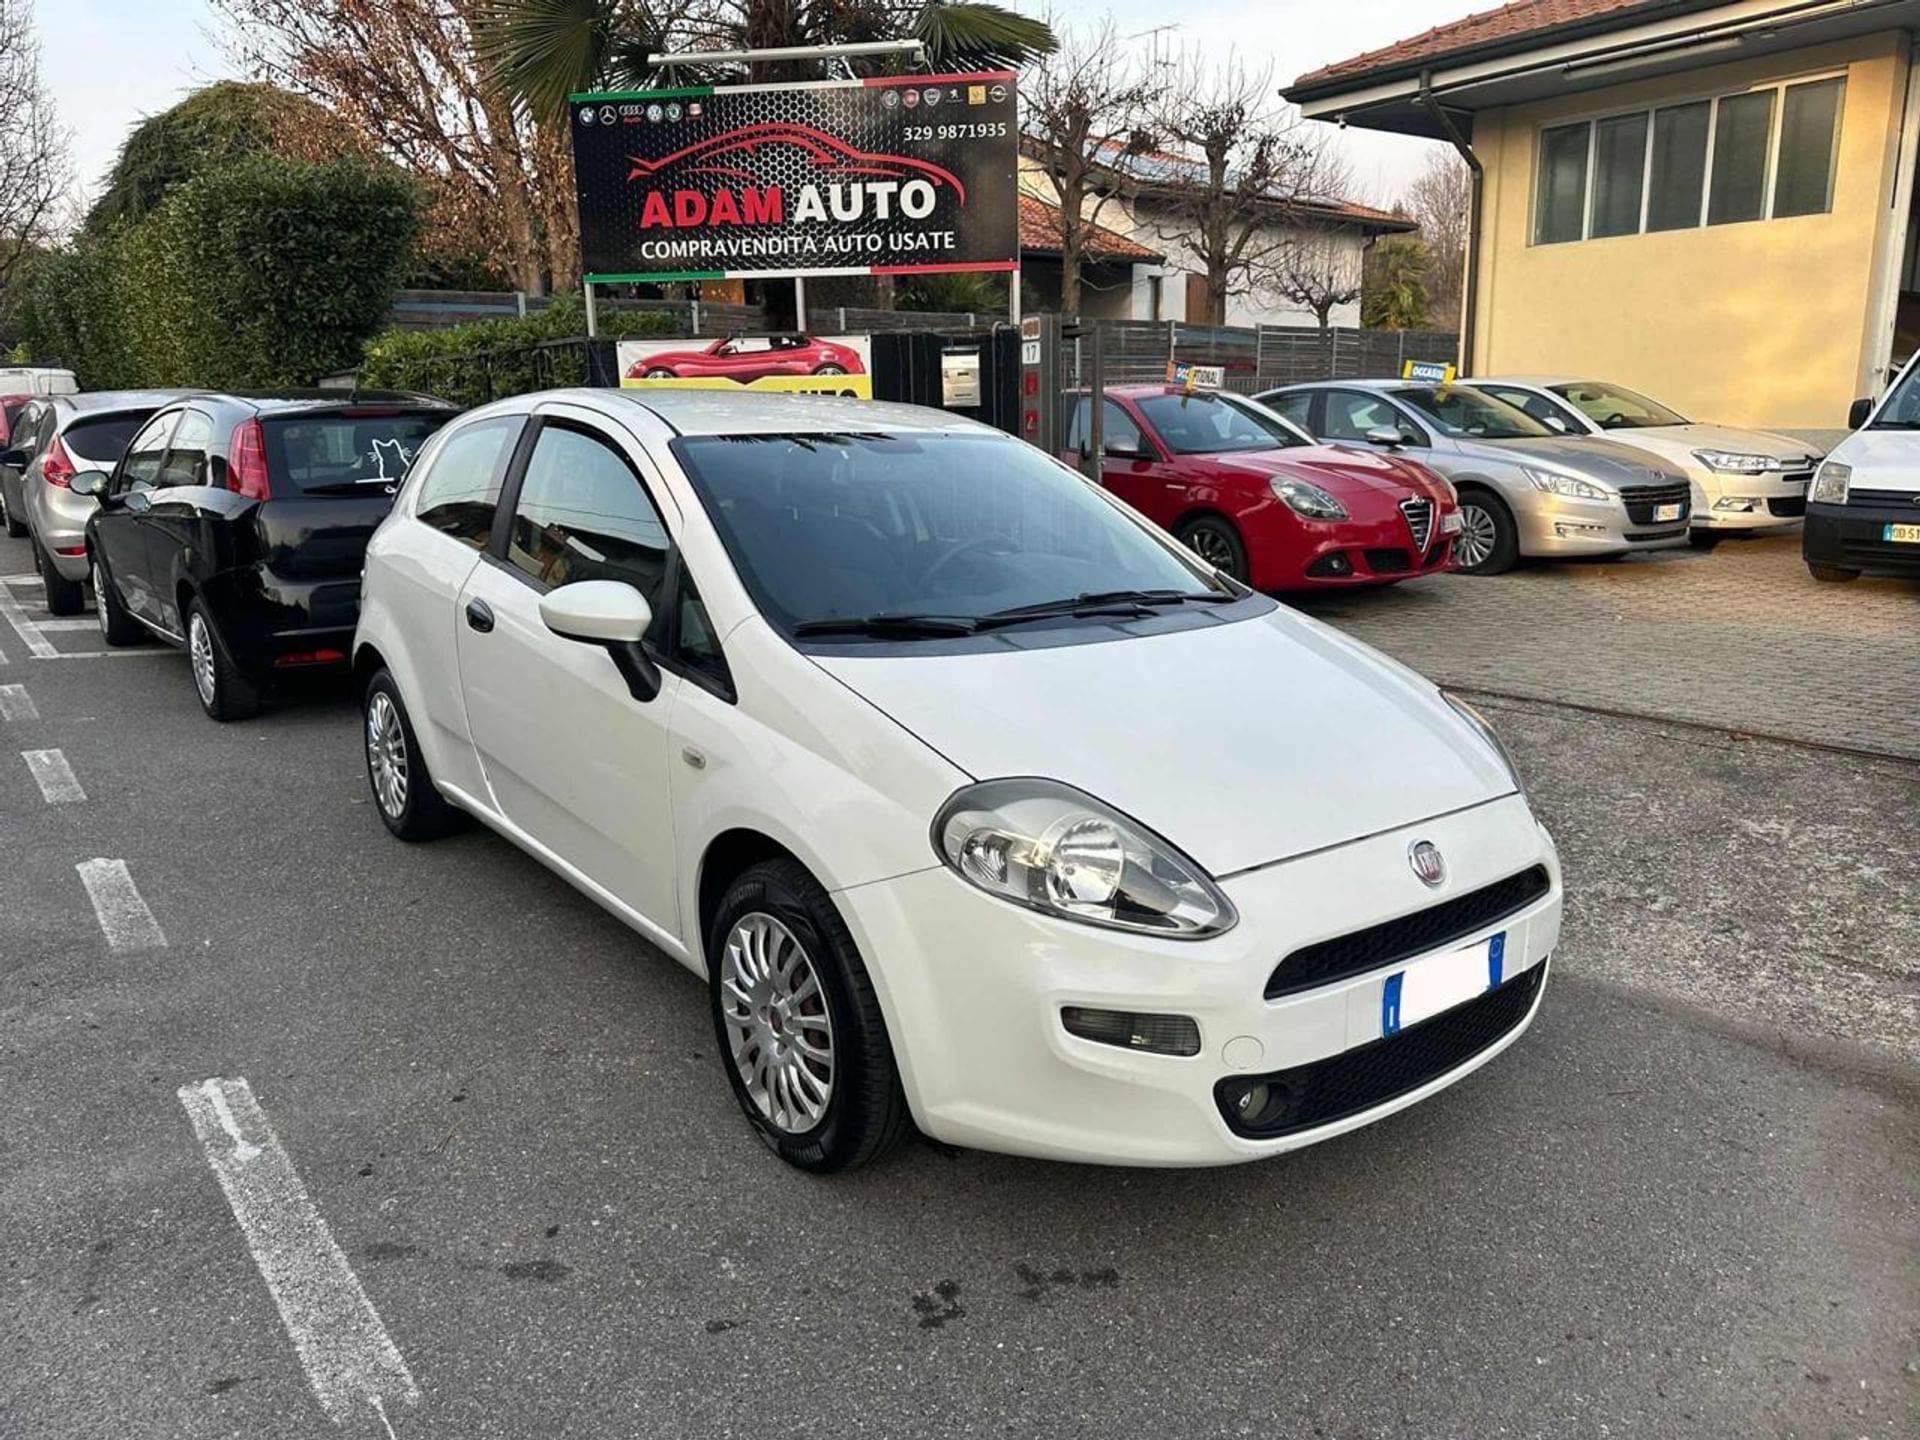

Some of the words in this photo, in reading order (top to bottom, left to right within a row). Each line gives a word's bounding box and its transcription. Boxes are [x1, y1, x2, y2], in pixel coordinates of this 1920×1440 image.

[903, 126, 933, 141] 329
[937, 122, 1007, 139] 9871935
[640, 186, 784, 229] ADAM
[794, 179, 937, 223] AUTO
[641, 235, 818, 260] COMPRAVENDITA
[823, 233, 882, 253] AUTO
[888, 230, 956, 251] USATE
[1026, 344, 1037, 361] 17
